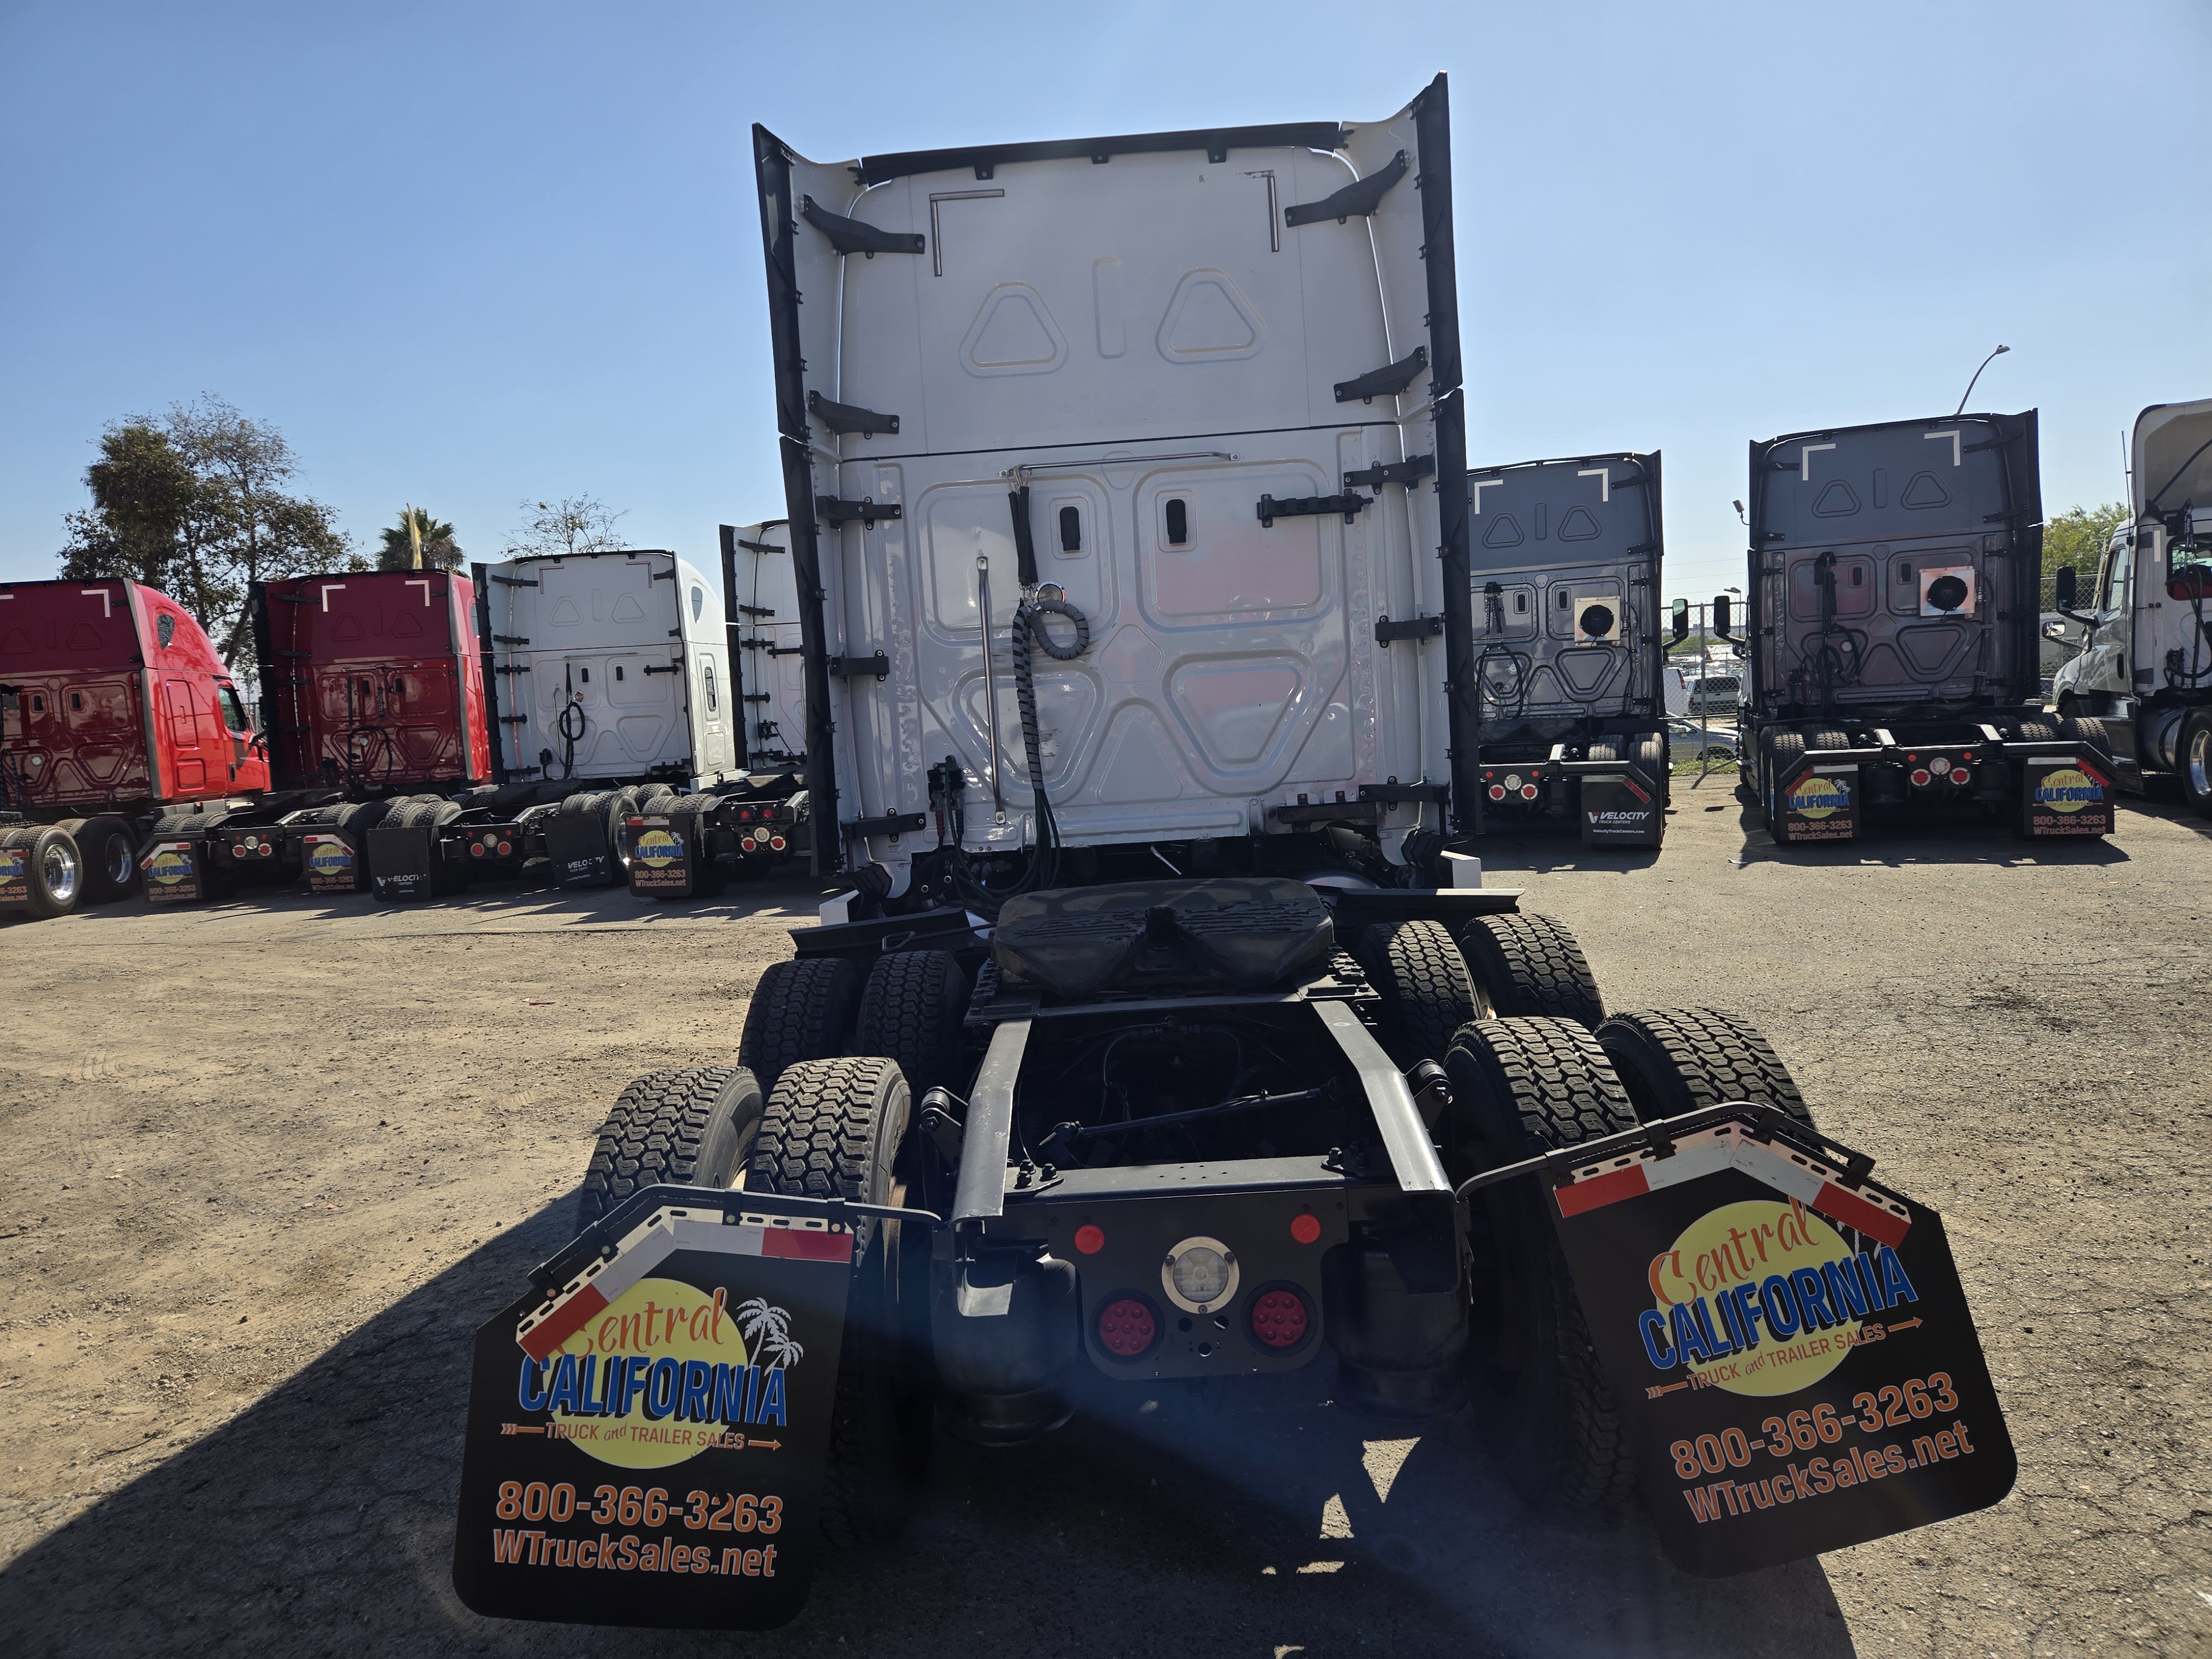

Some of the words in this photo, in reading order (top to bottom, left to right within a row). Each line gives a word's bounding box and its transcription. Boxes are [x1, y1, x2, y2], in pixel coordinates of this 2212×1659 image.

[2041, 769, 2085, 789] Central
[1788, 792, 1850, 809] CALIFORNIA
[2035, 786, 2104, 802] CALIFORNIA
[1788, 820, 1853, 831] 800-366-3263
[2033, 815, 2106, 825] 800-366-3263
[1788, 830, 1853, 840] WTruckSales.net
[2033, 826, 2106, 834] WTruckSales.net
[638, 831, 670, 847] Central
[634, 844, 684, 858] CALIFORNIA
[309, 856, 352, 868] CALIFORNIA
[568, 855, 604, 869] VELOCTY
[148, 863, 193, 878] CALIFORNIA
[0, 886, 27, 894] 6-3263
[635, 879, 686, 887] WTruckSales.net
[1648, 1196, 1820, 1307] Central
[1639, 1246, 1919, 1370] CALIFORNIA
[1686, 1363, 1741, 1390] TRUCK
[1745, 1350, 1766, 1376] and
[1766, 1338, 1832, 1369] TRAILER
[1834, 1323, 1887, 1350] SALES
[519, 1353, 787, 1427] CALIFORNIA
[1670, 1371, 1959, 1480] 800-366-3263
[546, 1422, 599, 1439] TRUCK
[604, 1422, 627, 1441] and
[630, 1426, 693, 1446] TRAILER
[697, 1431, 745, 1450] SALES
[1683, 1419, 1975, 1524] WTruckSales.net
[496, 1481, 784, 1534] 800-366-3263
[493, 1528, 778, 1577] WTruckSales.net
